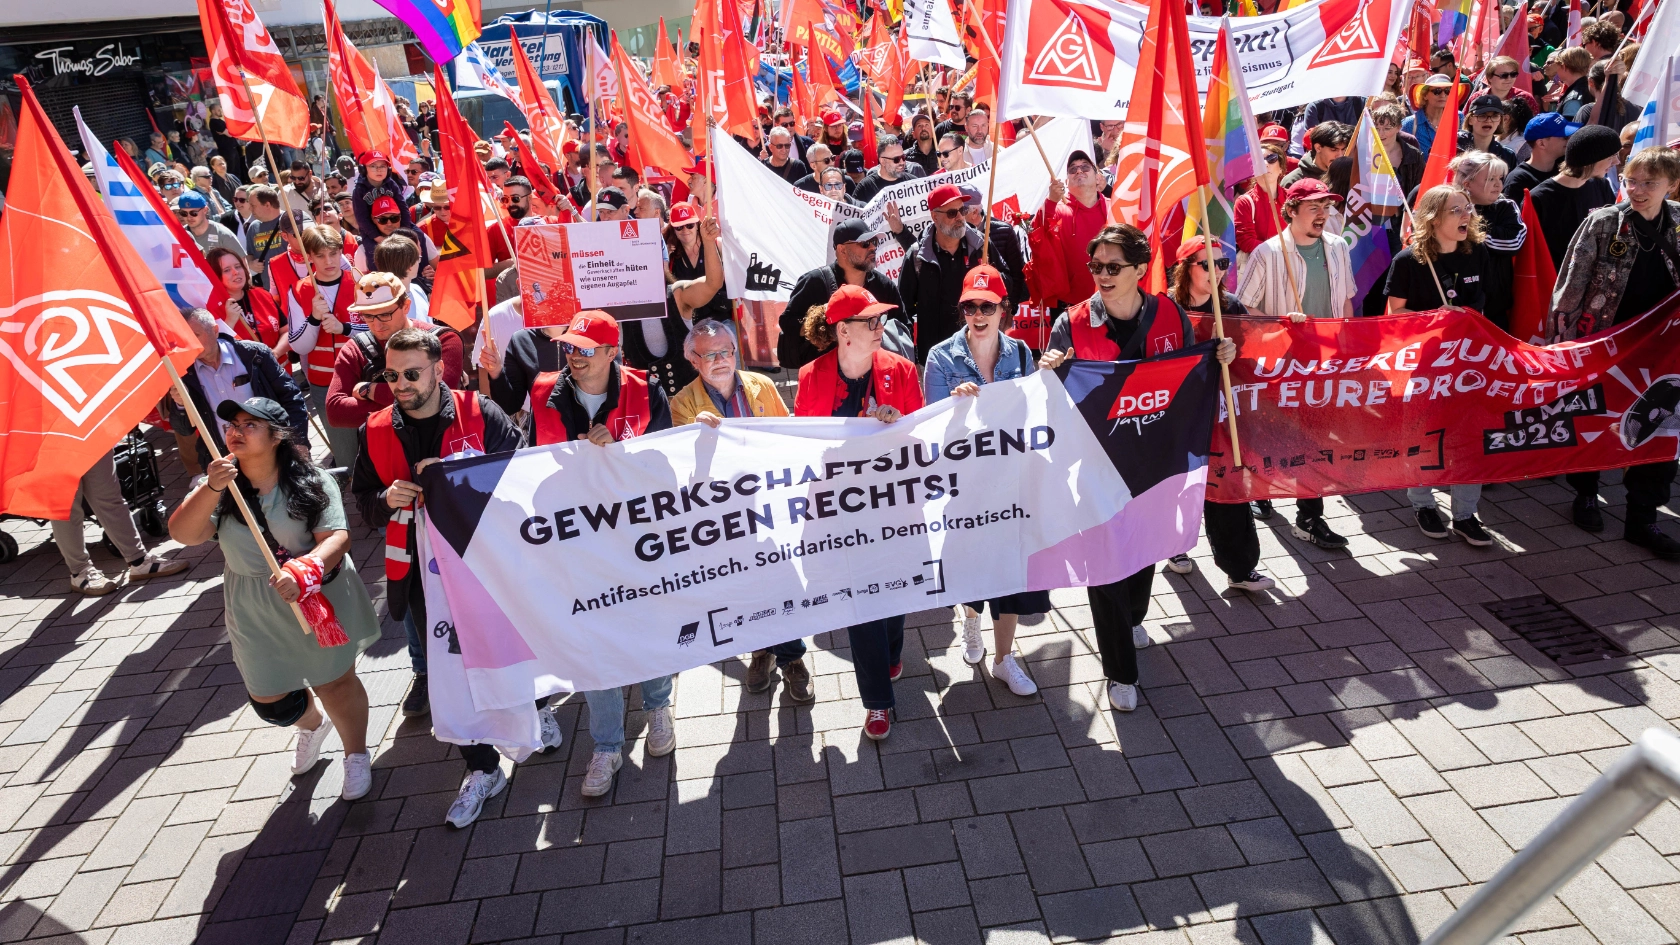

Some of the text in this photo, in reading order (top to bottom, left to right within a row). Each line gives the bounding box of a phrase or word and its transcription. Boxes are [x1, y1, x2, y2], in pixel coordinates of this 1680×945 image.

[1190, 26, 1280, 62] spekt!
[35, 42, 140, 76] Thomas Sabo
[792, 186, 832, 210] Gegen
[813, 210, 834, 226] Für
[551, 249, 605, 260] Wir müssen
[587, 259, 615, 269] Einheit
[625, 264, 648, 272] hüten
[580, 279, 638, 291] eigenen Augapfel!
[592, 274, 618, 282] unseren
[1253, 341, 1422, 379] UNSERE
[1119, 389, 1170, 413] DGB
[1217, 382, 1269, 424] ATT
[1277, 379, 1393, 409] EURE
[1488, 420, 1570, 450] 2026
[519, 425, 1056, 545] GEWERKSCHAFTSJUGEND
[634, 472, 960, 562] GEGEN RECHTS!
[571, 557, 749, 616] Antifaschistisch.
[754, 528, 875, 567] Solidarisch.
[881, 503, 1031, 540] Demokratisch.
